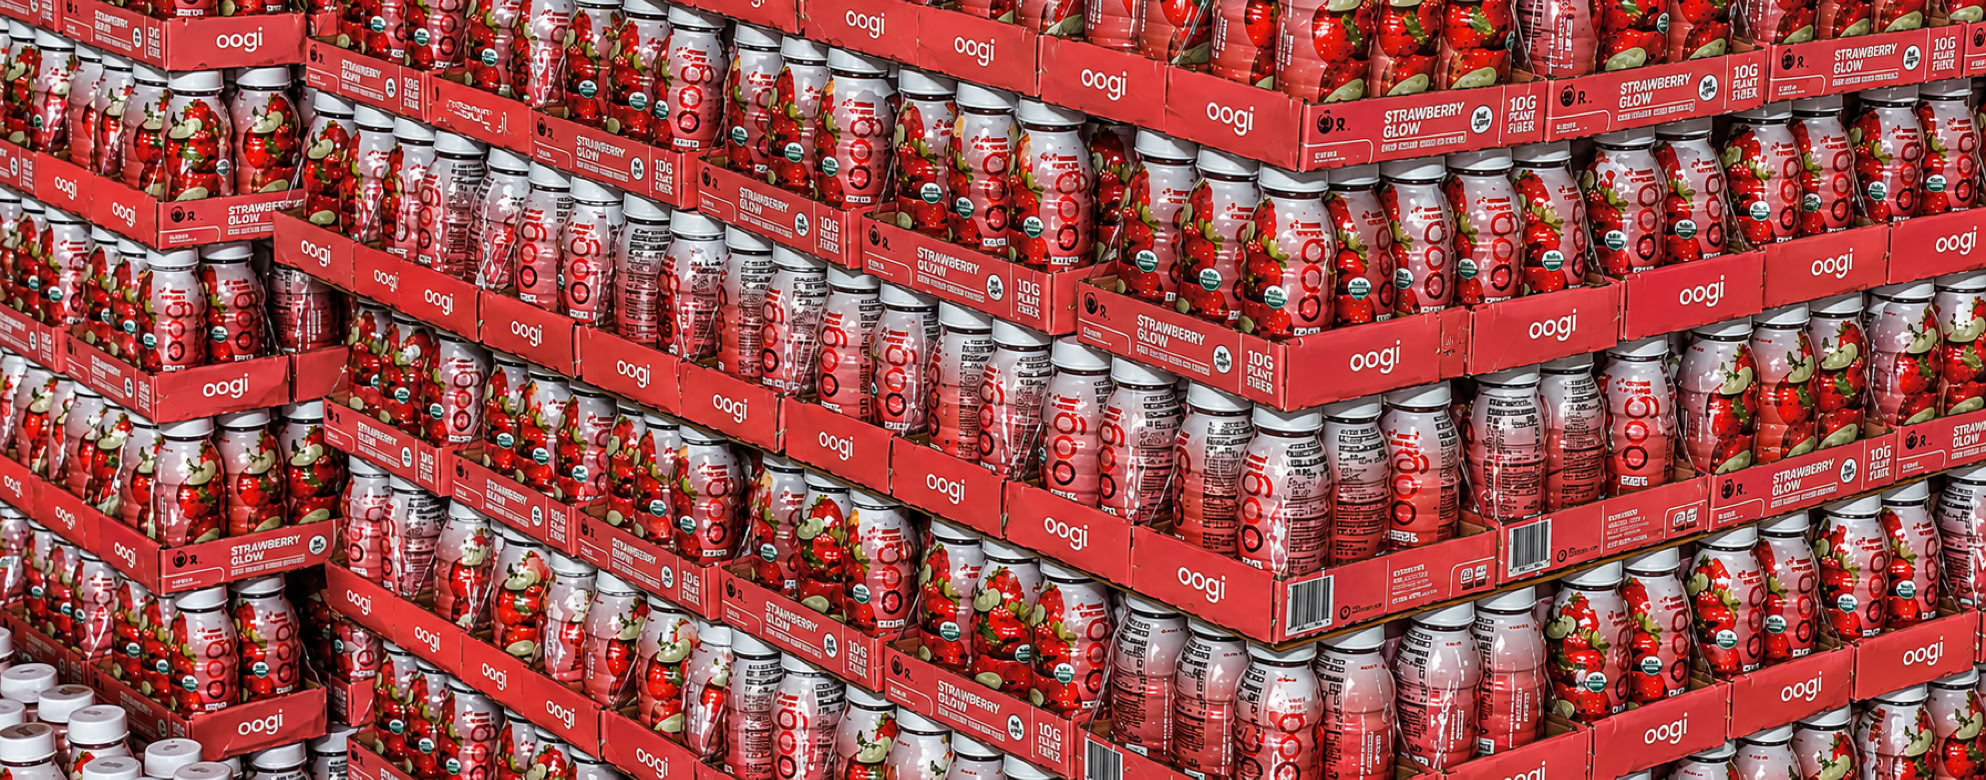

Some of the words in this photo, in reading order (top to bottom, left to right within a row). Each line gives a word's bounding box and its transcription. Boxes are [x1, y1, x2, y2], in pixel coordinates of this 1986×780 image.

[846, 11, 884, 38] oogi
[217, 27, 262, 52] oogi
[955, 37, 994, 66] oogi
[1835, 43, 1898, 61] STRAWBERRY
[1734, 63, 1758, 79] 10G
[1833, 59, 1864, 73] GLOW
[1082, 69, 1126, 100] oogi
[1620, 72, 1692, 95] STRAWBERRY
[1384, 102, 1465, 124] STRAWBERRY
[1510, 95, 1536, 111] 10G
[1619, 92, 1653, 108] GLOW
[1207, 102, 1254, 136] oogi
[1383, 121, 1421, 138] GLOW
[55, 177, 76, 200] oogi
[113, 202, 135, 227] oogi
[820, 216, 839, 232] 10G
[301, 240, 330, 267] oogi
[1936, 226, 1977, 255] oogi
[917, 247, 980, 275] STRAWBERRY
[1812, 248, 1853, 279] oogi
[1017, 278, 1040, 296] 10G
[1680, 275, 1724, 306] oogi
[425, 290, 453, 315] oogi
[512, 321, 542, 346] oogi
[1137, 314, 1205, 346] STRAWBERRY
[1529, 308, 1576, 341] oogi
[1137, 329, 1168, 348] GLOW
[1247, 350, 1273, 370] 10G
[1350, 340, 1400, 373] oogi
[203, 373, 248, 398] oogi
[617, 360, 650, 388] oogi
[713, 395, 747, 423] oogi
[819, 432, 853, 460] oogi
[1773, 458, 1834, 485] STRAWBERRY
[927, 474, 964, 504] oogi
[231, 534, 301, 556] STRAWBERRY
[1045, 517, 1088, 550] oogi
[115, 542, 135, 568] oogi
[1178, 567, 1225, 603] oogi
[347, 589, 371, 615] oogi
[415, 627, 440, 652] oogi
[1903, 636, 1943, 665] oogi
[482, 663, 506, 690] oogi
[1781, 671, 1822, 701] oogi
[937, 680, 1000, 714] STRAWBERRY
[238, 709, 282, 735] oogi
[546, 700, 574, 728] oogi
[1645, 712, 1687, 744] oogi
[636, 748, 668, 779] oogi
